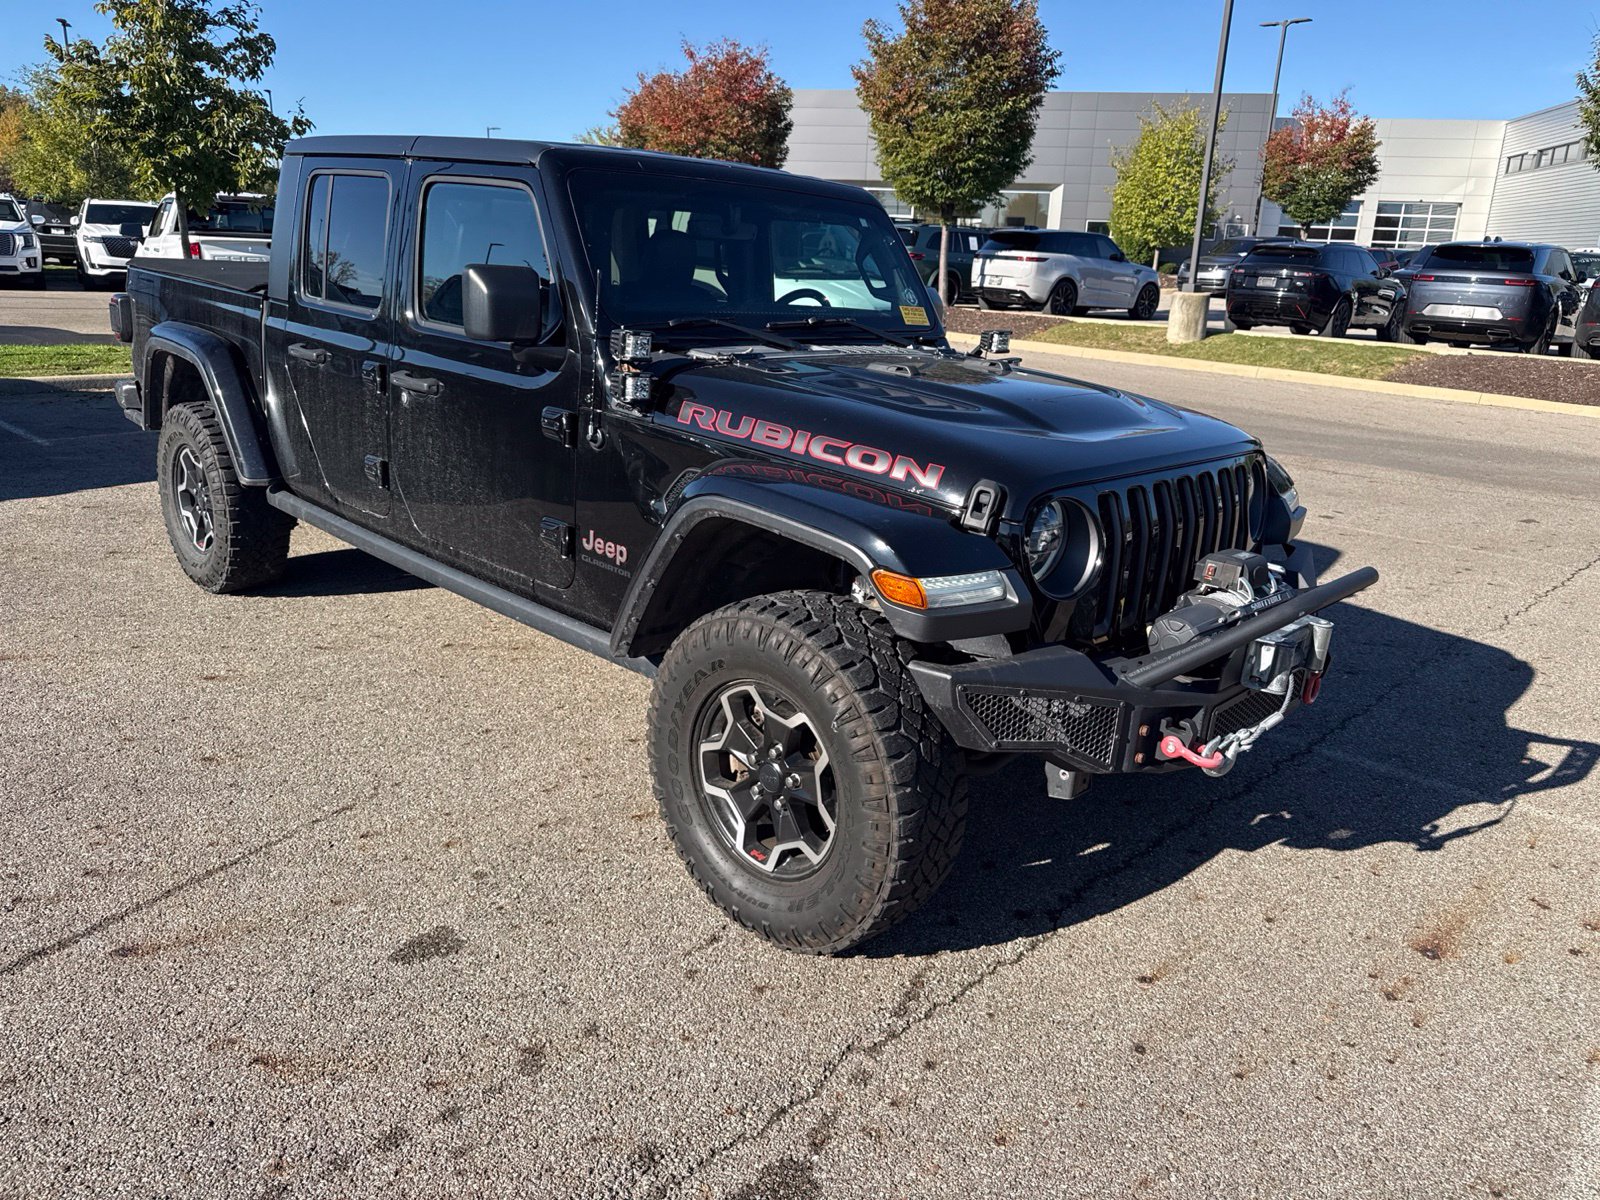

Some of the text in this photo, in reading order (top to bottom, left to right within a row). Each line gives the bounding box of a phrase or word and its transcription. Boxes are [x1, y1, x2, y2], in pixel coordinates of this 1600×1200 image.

[677, 400, 946, 490] RUBICON
[581, 554, 631, 579] GLADIATOR
[582, 529, 628, 566] Jeep
[667, 658, 726, 826] GOODYEAR
